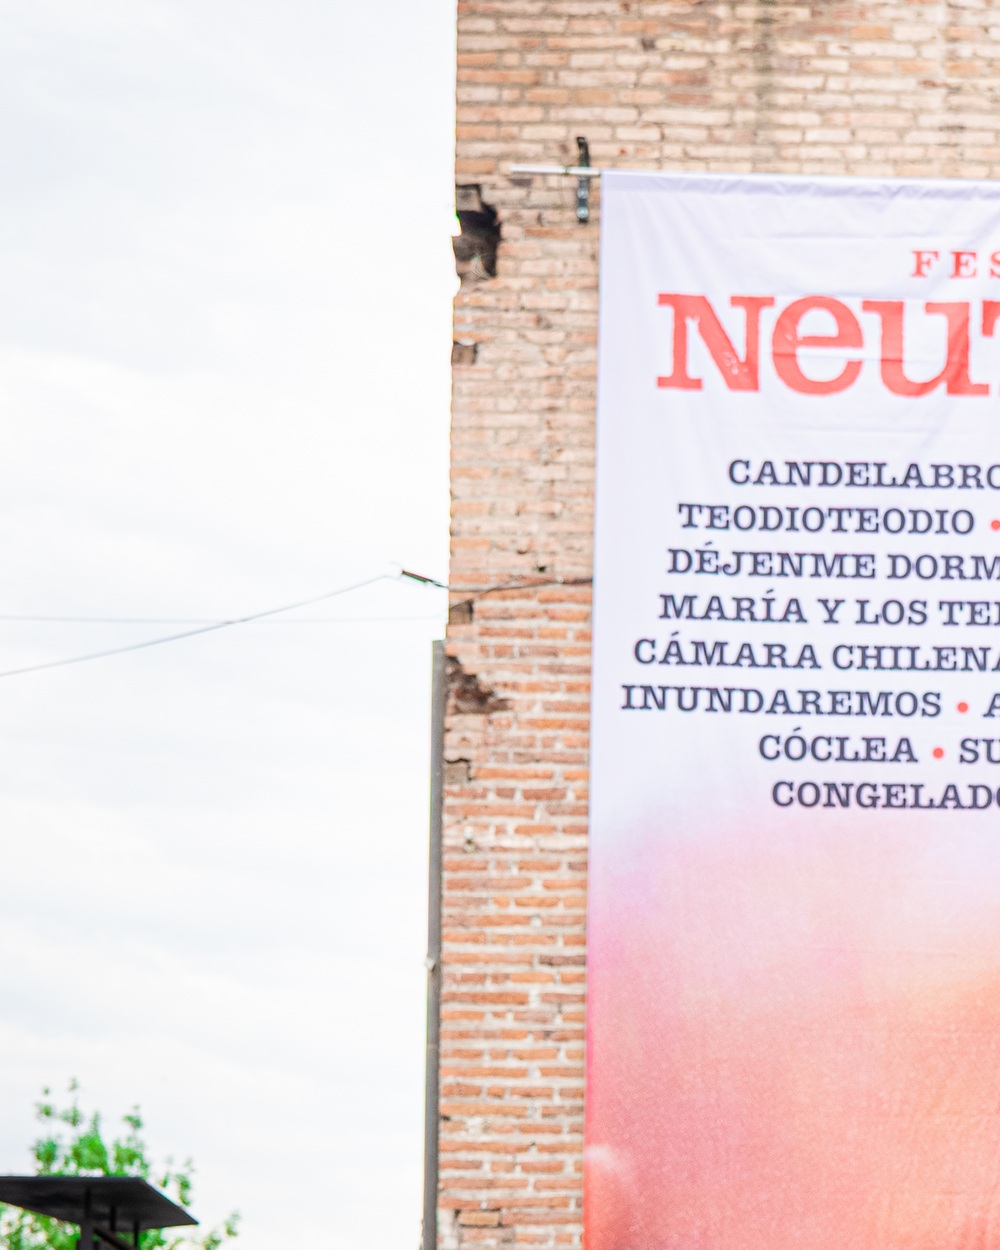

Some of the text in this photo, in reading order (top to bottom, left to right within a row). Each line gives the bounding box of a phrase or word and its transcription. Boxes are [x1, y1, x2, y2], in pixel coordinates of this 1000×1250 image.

[677, 503, 975, 535] TEODIOTEODIO
[666, 541, 877, 579] DÉJENME
[658, 588, 809, 623] MARÍA
[816, 598, 846, 624] Y
[854, 599, 929, 626] LOS
[633, 631, 823, 669] CÁMARA
[620, 684, 942, 717] INUNDAREMOS
[757, 727, 920, 763] CÓCLEA
